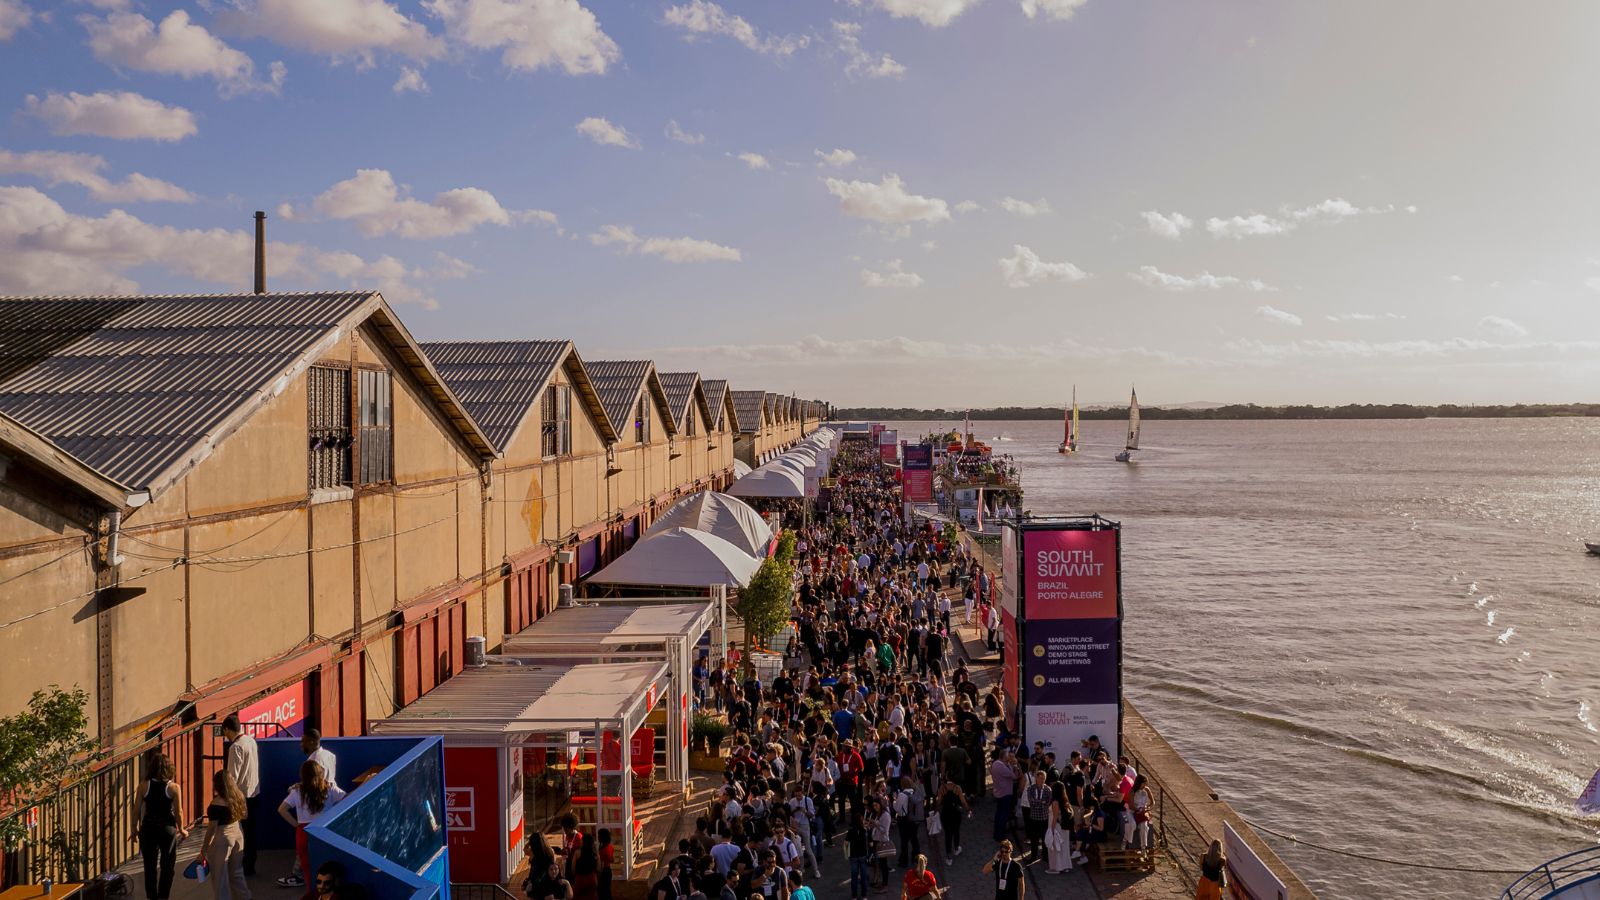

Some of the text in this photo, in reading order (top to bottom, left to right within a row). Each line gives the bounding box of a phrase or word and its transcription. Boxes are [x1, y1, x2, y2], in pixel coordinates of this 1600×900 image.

[1037, 550, 1093, 564] SOUTH
[1037, 563, 1104, 577] SUMMIT
[1037, 582, 1069, 590] BRAZIL
[1037, 591, 1104, 600] PORTO ALEGRE
[1038, 711, 1066, 719] SOUTH
